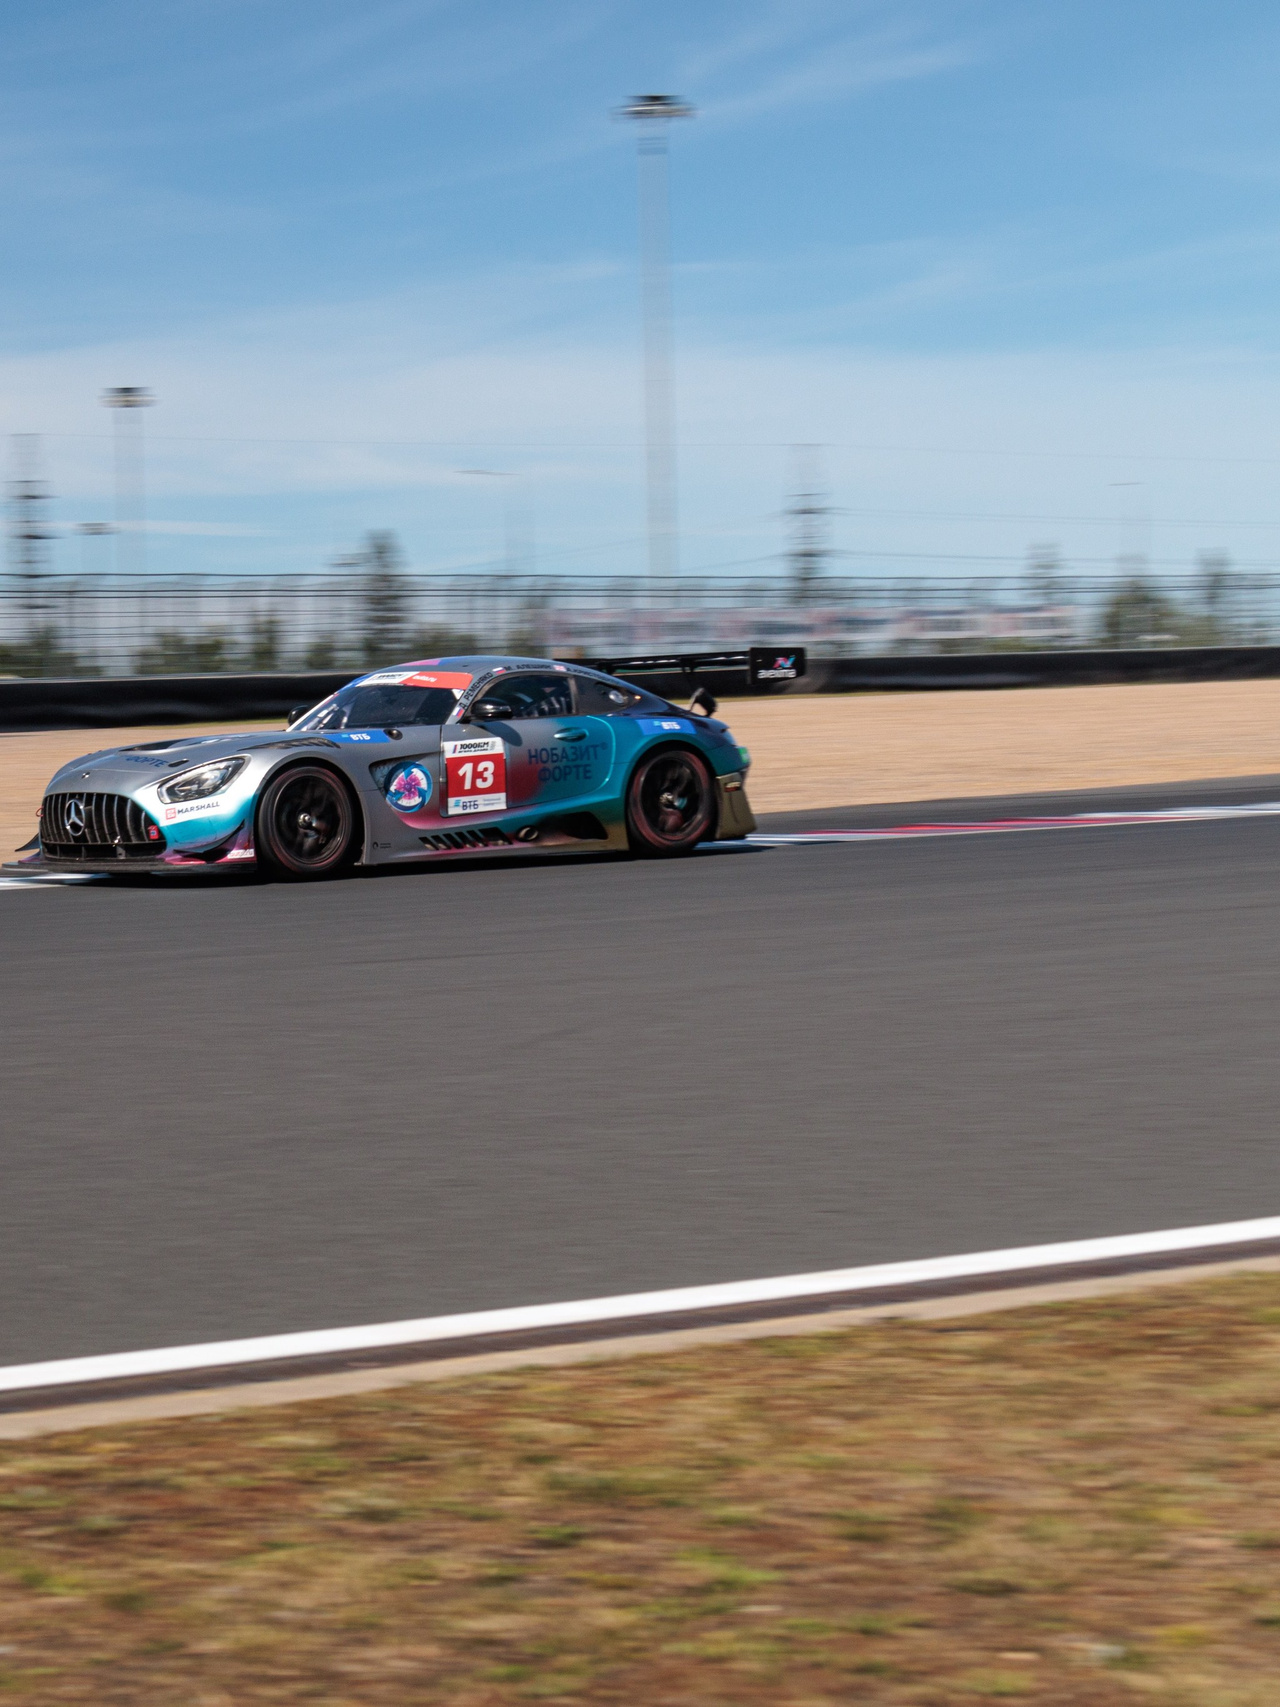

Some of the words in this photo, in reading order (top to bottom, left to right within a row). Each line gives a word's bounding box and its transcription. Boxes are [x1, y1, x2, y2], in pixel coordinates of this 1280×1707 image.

[349, 733, 371, 741] ВТБ
[458, 761, 494, 790] 13
[537, 763, 592, 782] ФОРТЕ
[177, 801, 220, 815] MARSHALL
[462, 800, 479, 811] ВТБ
